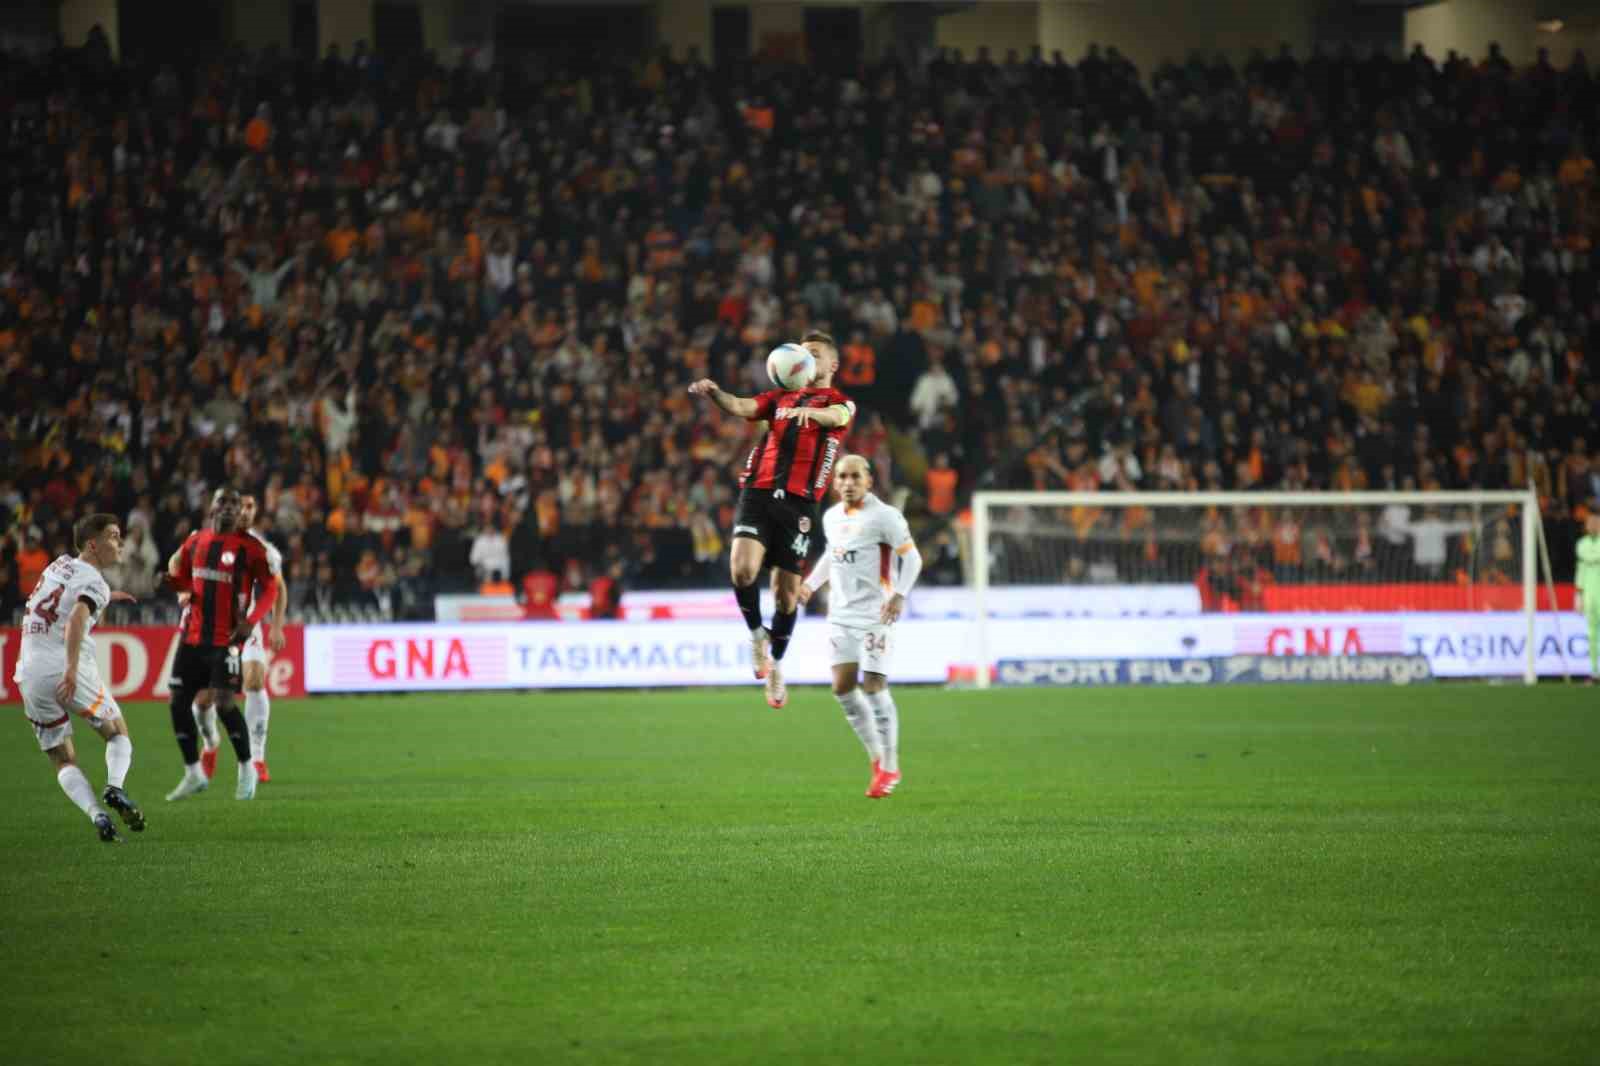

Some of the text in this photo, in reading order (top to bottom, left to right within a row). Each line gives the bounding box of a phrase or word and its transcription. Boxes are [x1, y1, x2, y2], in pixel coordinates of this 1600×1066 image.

[864, 632, 887, 652] 34
[1266, 627, 1590, 661] GNA TAŞIMAC
[225, 655, 240, 675] 11
[367, 638, 752, 680] GNA TAŞIMACILI
